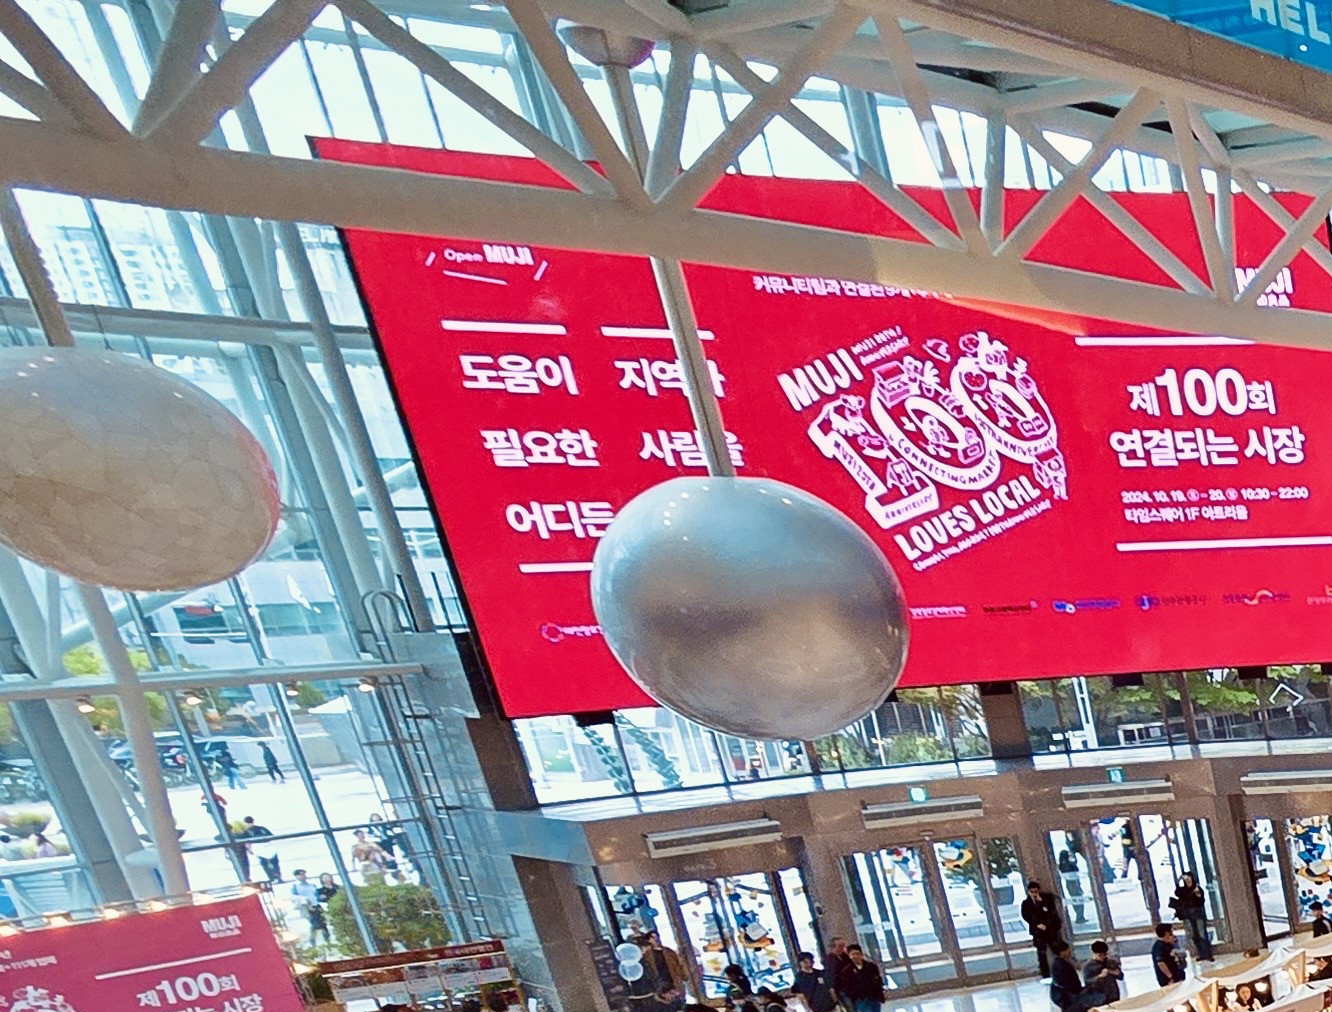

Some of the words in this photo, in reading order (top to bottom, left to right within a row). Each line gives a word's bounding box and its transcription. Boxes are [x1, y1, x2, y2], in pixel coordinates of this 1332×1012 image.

[443, 249, 483, 263] Open
[482, 244, 534, 265] MUJI
[459, 354, 579, 395] 도움이
[613, 357, 726, 398] 지역
[777, 348, 864, 412] MUJI
[1126, 367, 1277, 417] 제100회
[479, 427, 601, 468] 필요한
[1109, 427, 1240, 468] 연결되는
[1244, 425, 1306, 465] 시장
[505, 500, 615, 540] 어디든
[893, 504, 976, 562] LOVES
[970, 475, 1041, 525] LOCAL
[1184, 507, 1200, 520] 1F
[201, 914, 242, 932] MUJI
[136, 972, 241, 1008] 제100회
